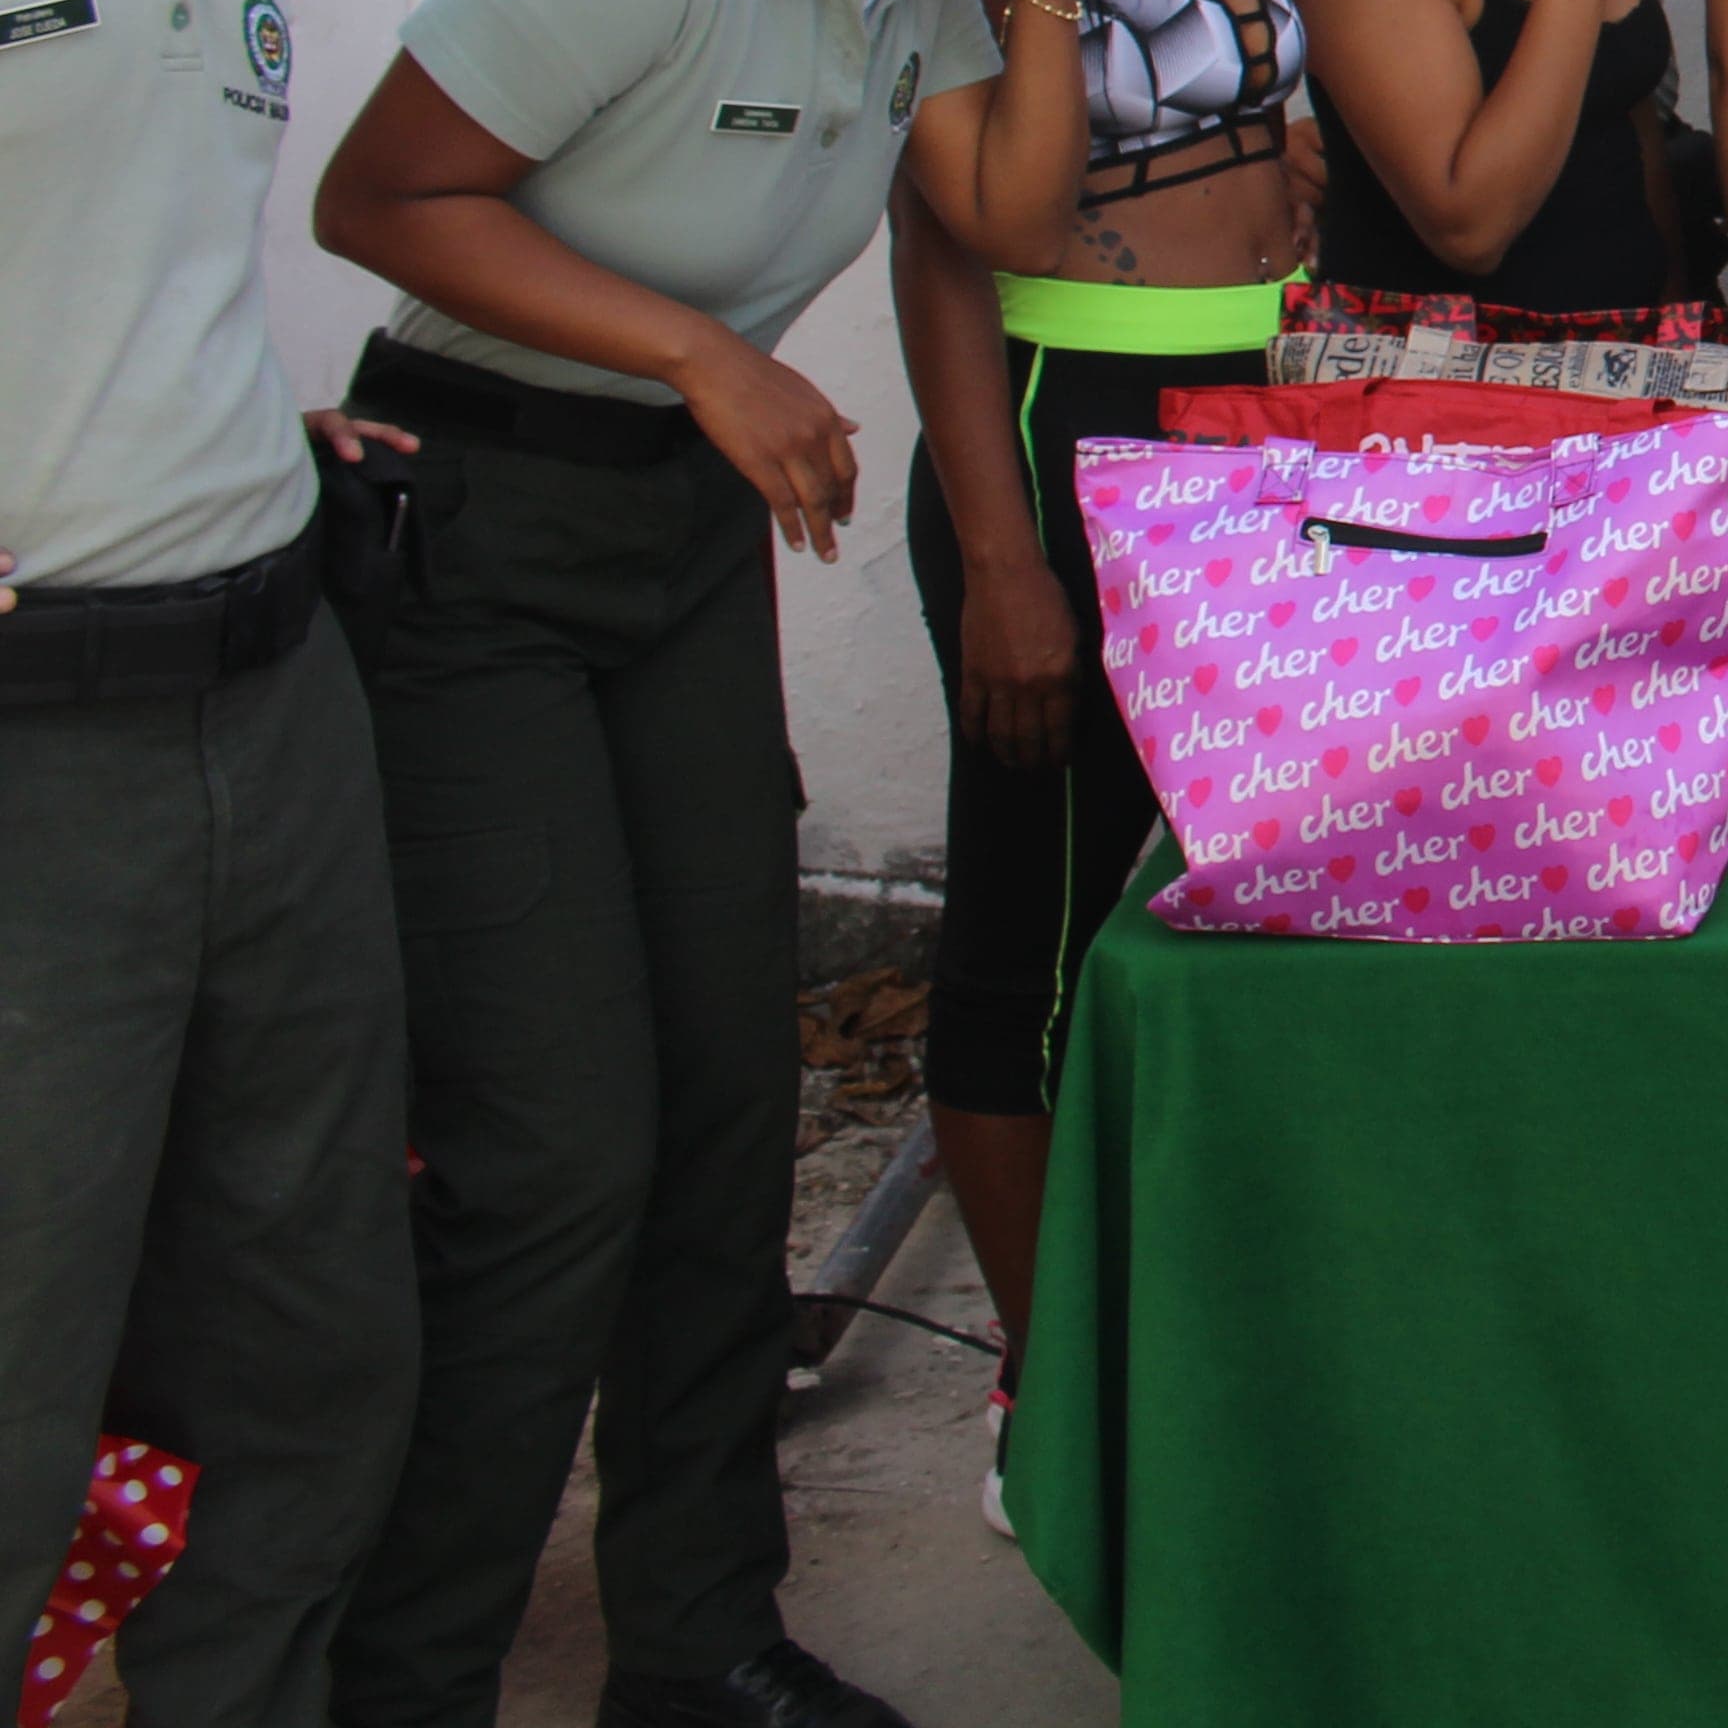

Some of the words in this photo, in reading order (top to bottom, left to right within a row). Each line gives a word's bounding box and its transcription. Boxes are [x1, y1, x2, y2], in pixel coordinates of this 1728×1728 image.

[1093, 526, 1145, 568] her
[1191, 505, 1280, 543] cher
[1136, 467, 1226, 510] cher
[1327, 486, 1420, 528] cher
[1466, 475, 1549, 523] cher
[1103, 631, 1138, 669] her
[1174, 601, 1265, 648] cher
[1313, 579, 1405, 623] cher
[1452, 562, 1543, 600] cher
[1580, 517, 1669, 562] cher
[1127, 670, 1190, 721] cher
[1235, 642, 1328, 690] cher
[1375, 615, 1467, 663] cher
[1513, 588, 1600, 632] cher
[1645, 556, 1728, 605] cher
[1170, 710, 1254, 761] cher
[1301, 680, 1391, 731] cher
[1439, 655, 1529, 700] cher
[1574, 624, 1660, 671] cher
[1229, 752, 1319, 803] cher
[1367, 722, 1458, 773] cher
[1509, 691, 1590, 741] cher
[1631, 660, 1706, 710] cher
[1184, 824, 1250, 865] her
[1300, 793, 1391, 844] cher
[1441, 761, 1532, 811] cher
[1581, 731, 1655, 782] cher
[1234, 864, 1326, 905] cher
[1375, 831, 1465, 877] cher
[1514, 803, 1604, 849] cher
[1650, 768, 1726, 819] cher
[1310, 896, 1400, 933] cher
[1449, 866, 1539, 911] cher
[1586, 843, 1675, 892] cher
